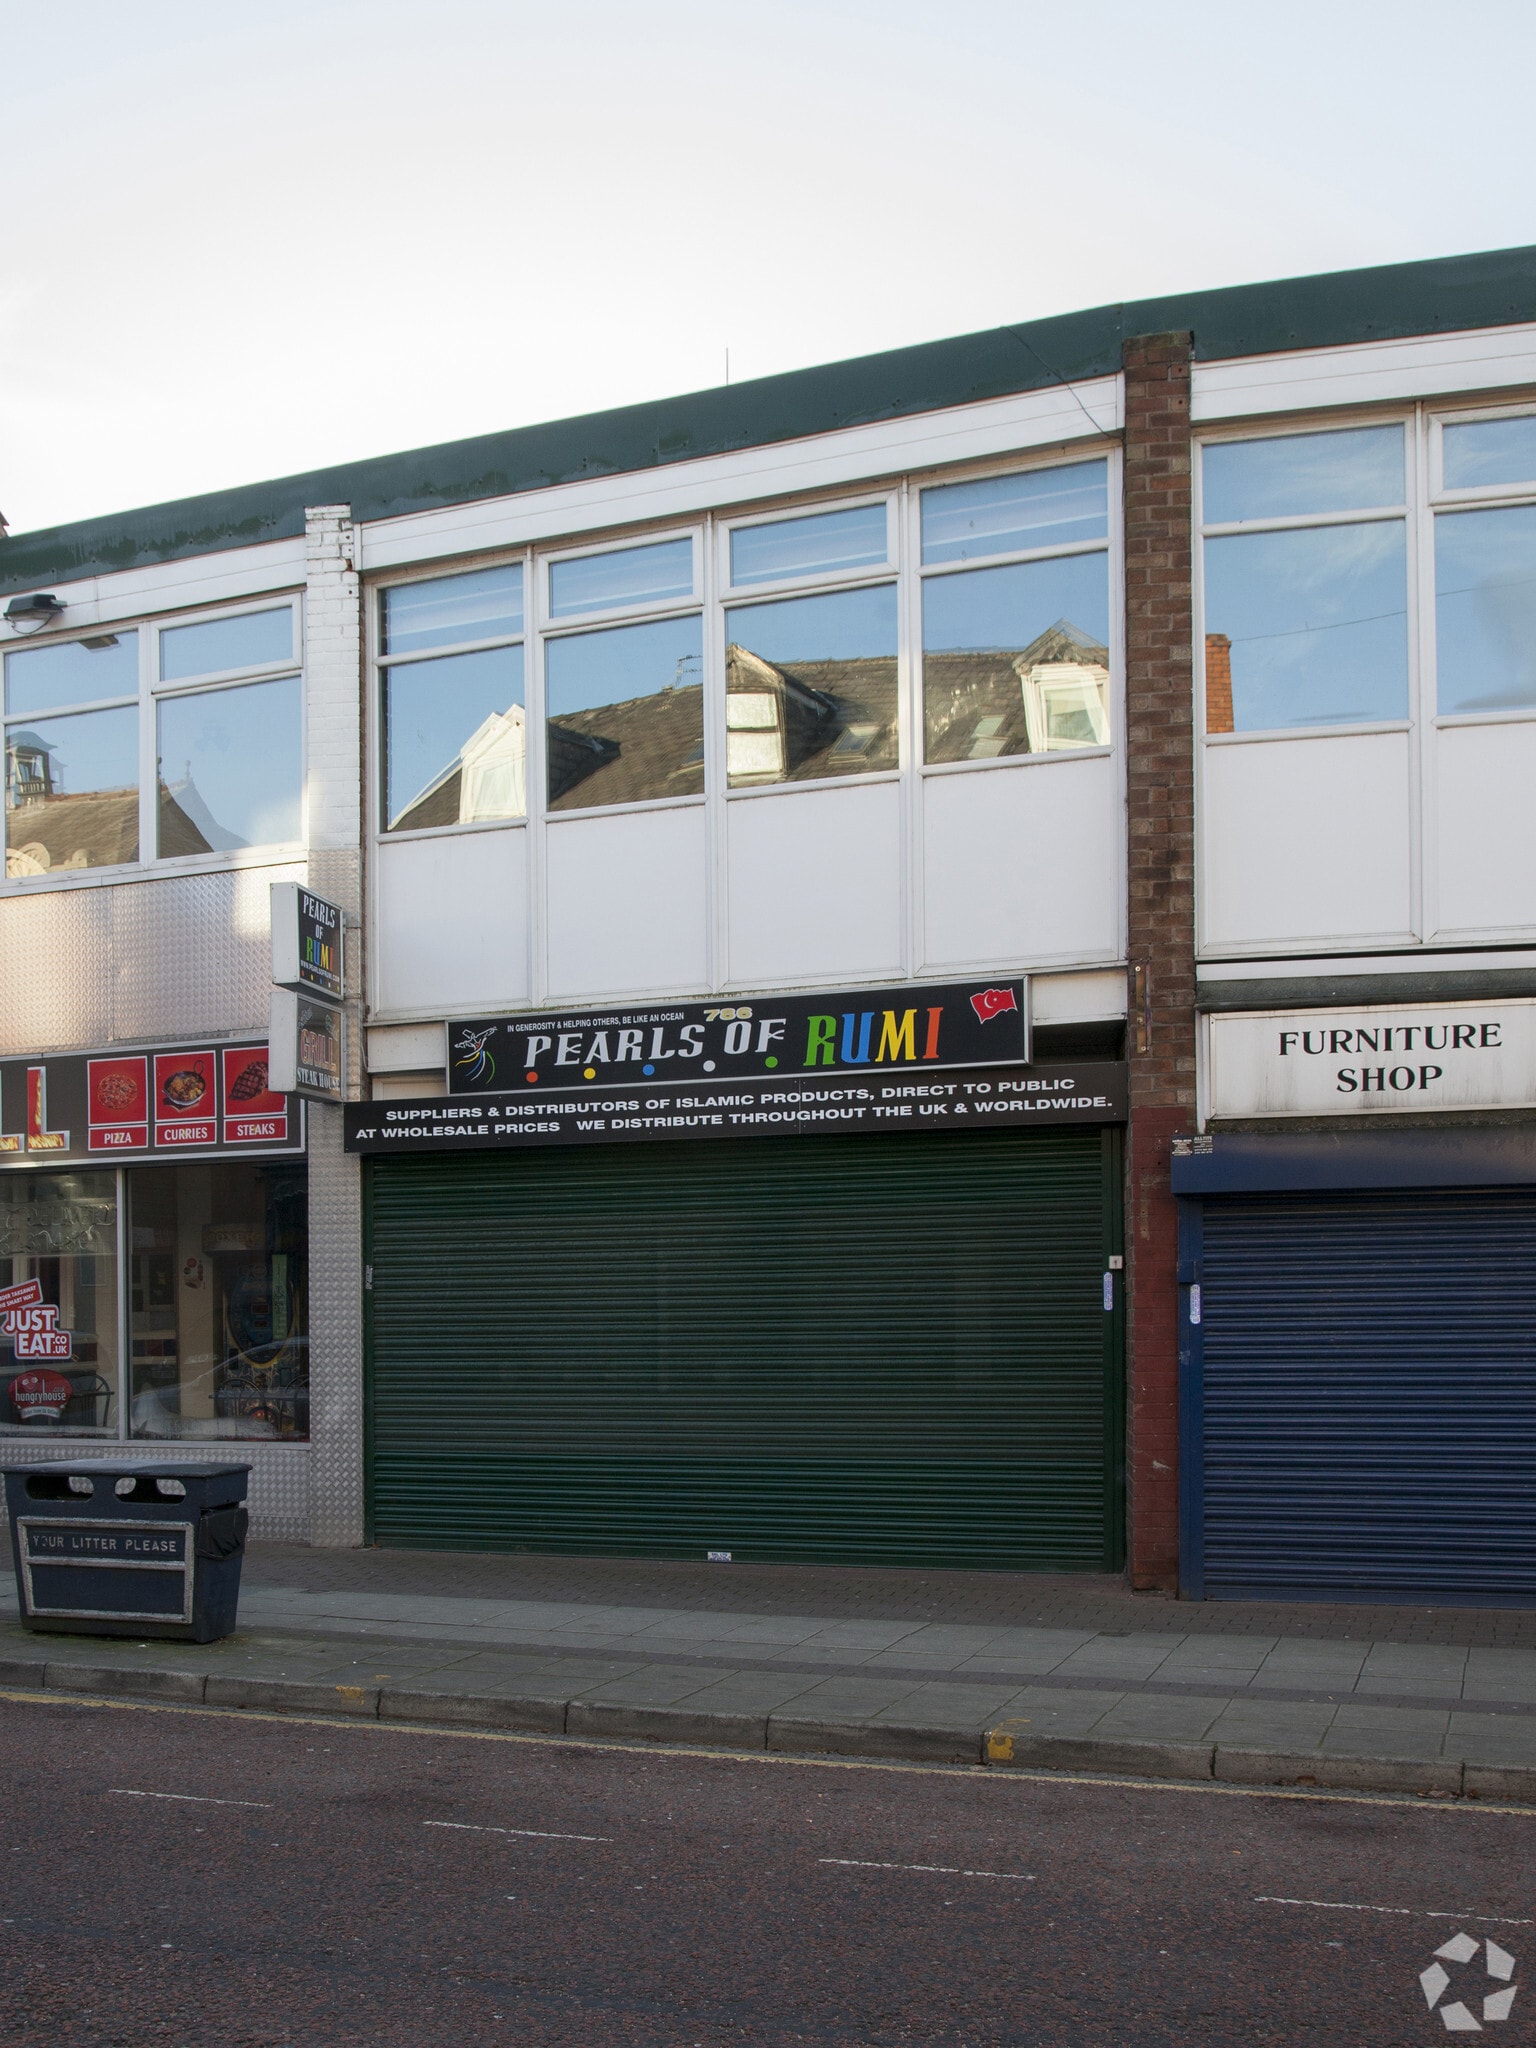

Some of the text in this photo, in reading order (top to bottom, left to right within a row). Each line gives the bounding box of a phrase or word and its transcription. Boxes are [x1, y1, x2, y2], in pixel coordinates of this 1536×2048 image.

[303, 894, 335, 928] PEARLS
[315, 924, 324, 940] OF
[306, 936, 334, 971] RUMI
[507, 1012, 684, 1033] IN GENEROSITY & HELPING OTHERS, BE LIKE AN OCEAN
[704, 1007, 753, 1022] 786
[523, 1007, 944, 1068] PEARLS OF RUMI
[1278, 1022, 1503, 1056] FURNITURE
[301, 1028, 337, 1072] GRILL
[297, 1066, 340, 1091] STEAK HOUSE
[1336, 1065, 1443, 1093] SHOP
[386, 1078, 1075, 1121] SUPPLIERS & DISTRIBUTORS OF ISLAMIC PRODUCTS, DIRECT TO PUBLIC
[356, 1096, 1112, 1139] AT WHOLESALE PRICES WE DISTRIBUTE THROUGHOUT THE UK & WORLDWIDE.
[104, 1132, 132, 1145] PIZZA
[164, 1127, 208, 1141] CURRIES
[237, 1123, 275, 1137] STEAKS
[6, 1296, 22, 1307] SMART
[22, 1293, 34, 1302] WAY
[11, 1285, 36, 1297] TAKEAWAY
[6, 1309, 55, 1331] JUST
[18, 1333, 55, 1354] EAT
[15, 1379, 66, 1404] hungryhouse
[72, 1537, 117, 1550] LITTER
[126, 1540, 176, 1552] PLEASE
